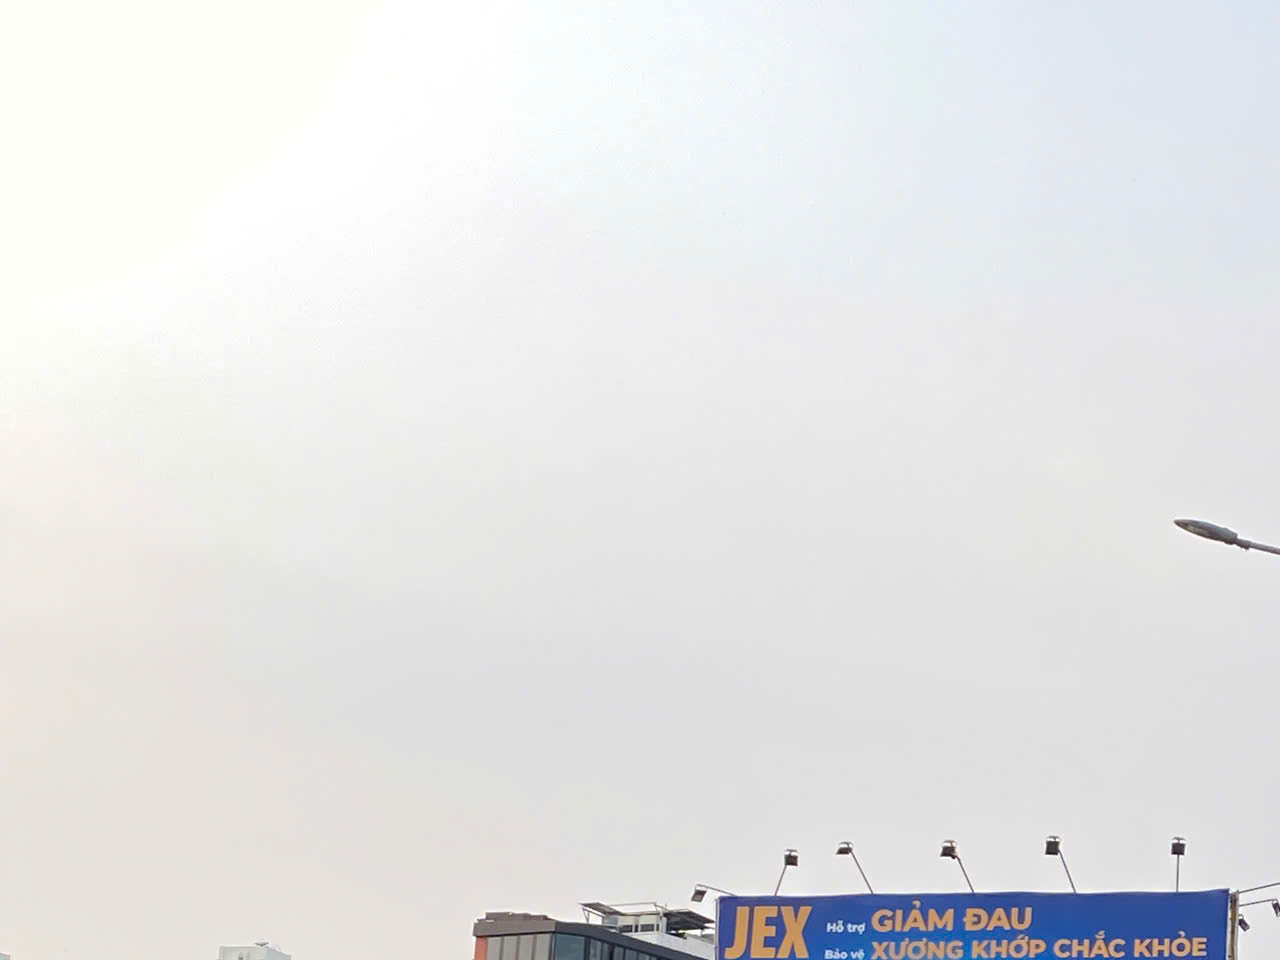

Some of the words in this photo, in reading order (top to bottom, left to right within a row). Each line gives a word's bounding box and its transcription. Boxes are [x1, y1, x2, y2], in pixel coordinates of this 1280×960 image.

[826, 920, 844, 933] Hỗ
[847, 922, 866, 935] trợ
[871, 900, 954, 932] GIẢM
[963, 906, 1033, 931] ĐAU
[724, 906, 812, 960] JEX
[870, 937, 964, 960] XƯƠNG
[971, 935, 1047, 960] KHỚP
[1053, 930, 1126, 959] CHẮC
[1133, 931, 1207, 958] KHỎE
[824, 949, 848, 960] Bảo
